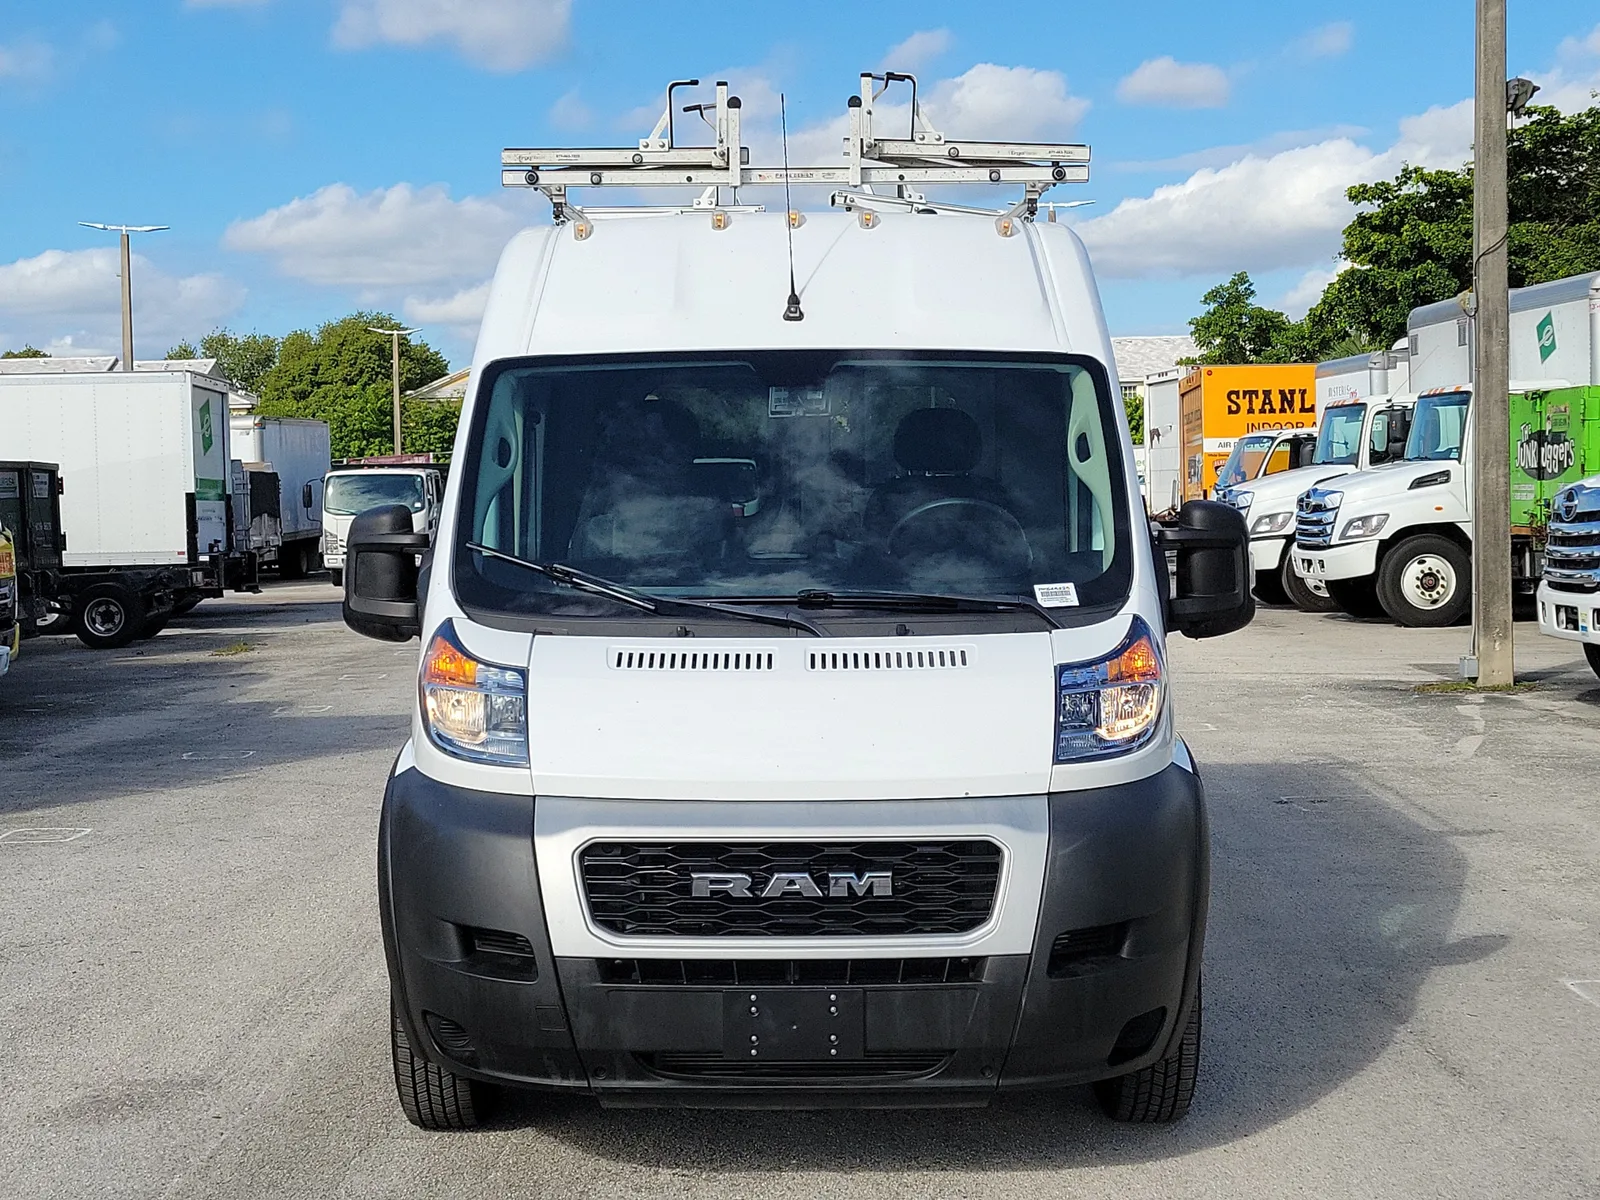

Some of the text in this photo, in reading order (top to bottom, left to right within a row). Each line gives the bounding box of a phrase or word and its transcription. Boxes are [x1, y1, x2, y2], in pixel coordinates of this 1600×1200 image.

[1226, 388, 1316, 415] STANL
[1217, 441, 1232, 449] AIR
[690, 871, 893, 898] RAM
